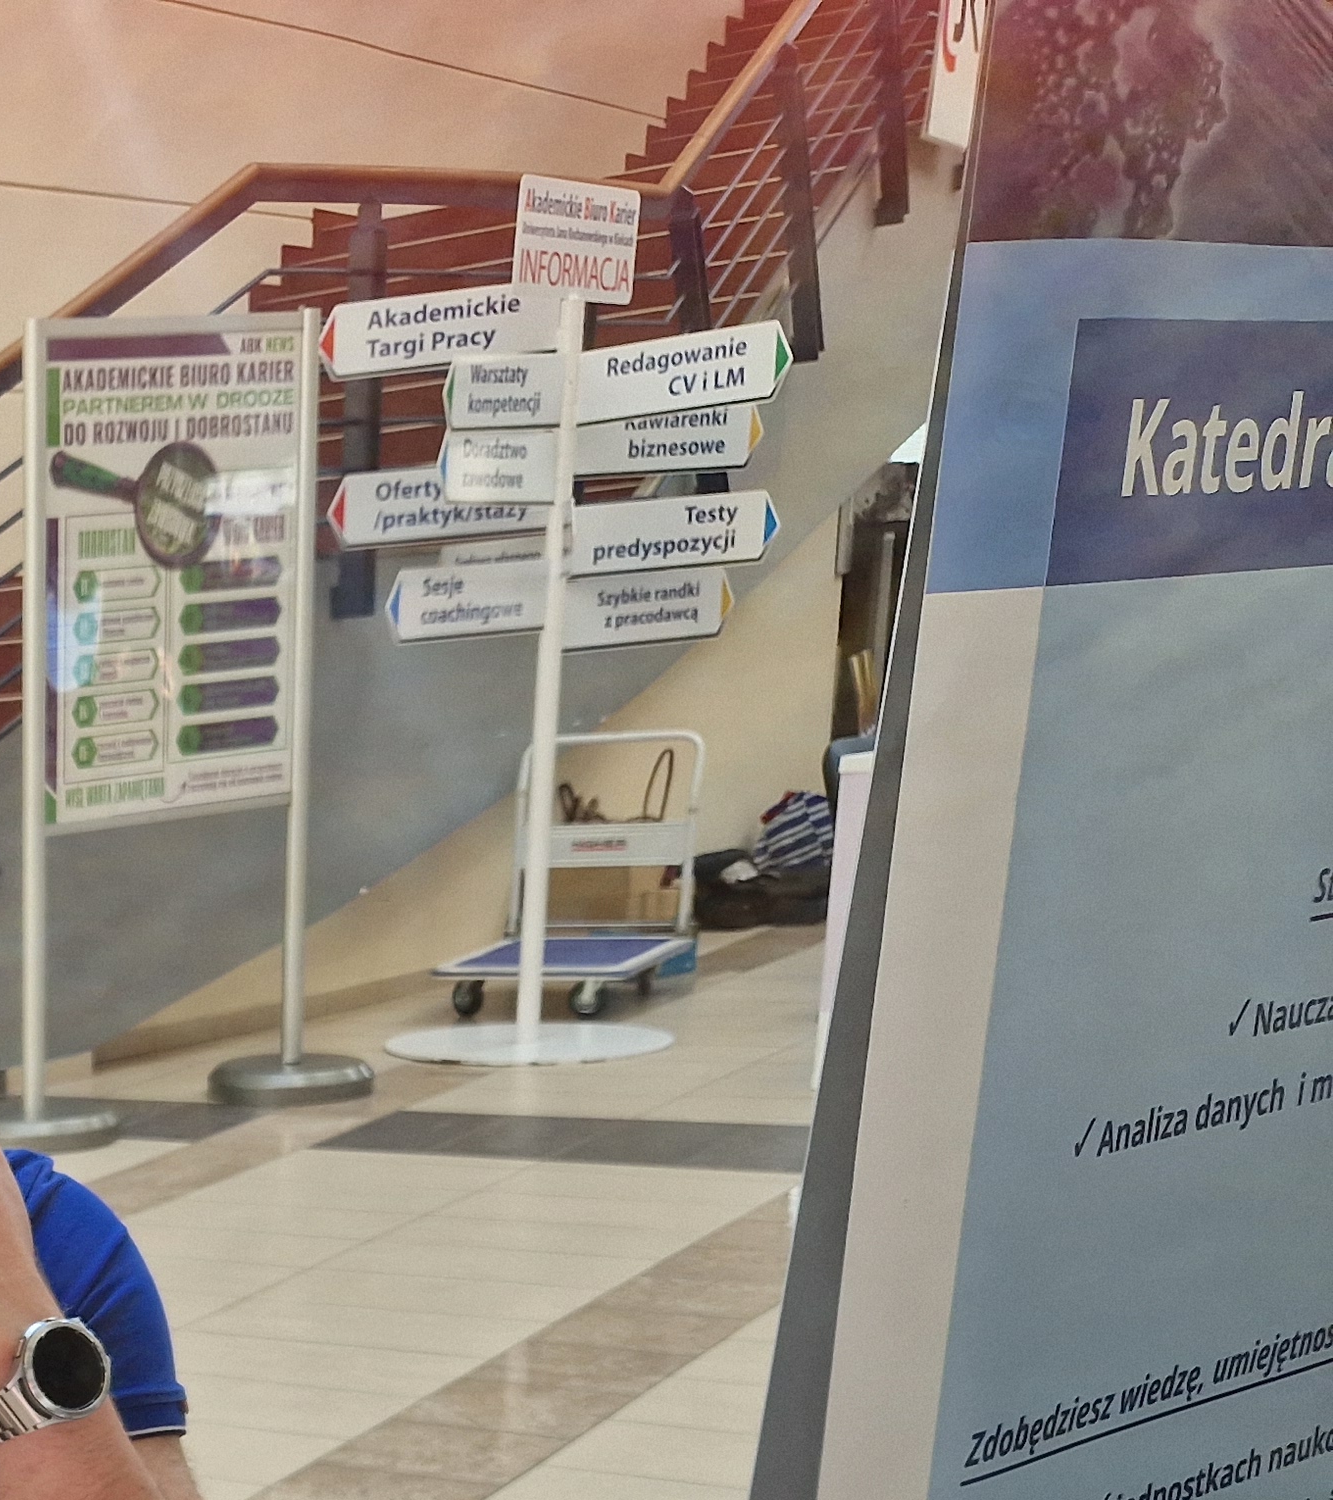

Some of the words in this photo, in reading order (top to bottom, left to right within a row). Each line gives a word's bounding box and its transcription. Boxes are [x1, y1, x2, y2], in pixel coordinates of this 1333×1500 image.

[519, 248, 630, 292] INFORMACJA
[367, 294, 521, 330] Akademickie
[366, 333, 425, 359] Targi
[432, 329, 496, 350] Pracy
[607, 337, 747, 377] Redagowanie
[62, 365, 174, 393] AKADEMICKIE
[179, 363, 231, 388] BIURO
[236, 360, 295, 384] KARIER
[470, 364, 528, 388] Warsztaty
[669, 373, 698, 396] CV
[703, 372, 708, 391] i
[714, 367, 745, 390] LM
[63, 394, 183, 415] PARTNEREM
[188, 393, 209, 410] W
[467, 392, 541, 417] kompetencji
[63, 423, 86, 447] DO
[93, 419, 168, 444] ROZWOJU
[186, 412, 293, 441] DOBROSTANU
[1121, 390, 1333, 498] Katedr
[628, 439, 726, 459] biznesowe
[375, 481, 441, 501] Oferty
[685, 506, 738, 525] Testy
[593, 529, 736, 564] predyspozycji
[422, 575, 464, 597] Sesje
[597, 587, 651, 608] Szybkie
[654, 582, 700, 600] randki
[604, 617, 612, 628] z
[1096, 1105, 1187, 1157] Analiza
[1194, 1078, 1284, 1130] danych
[1296, 1072, 1307, 1106] i
[963, 1395, 1115, 1468] Zdobędziesz
[1119, 1364, 1203, 1412] wiedzę,
